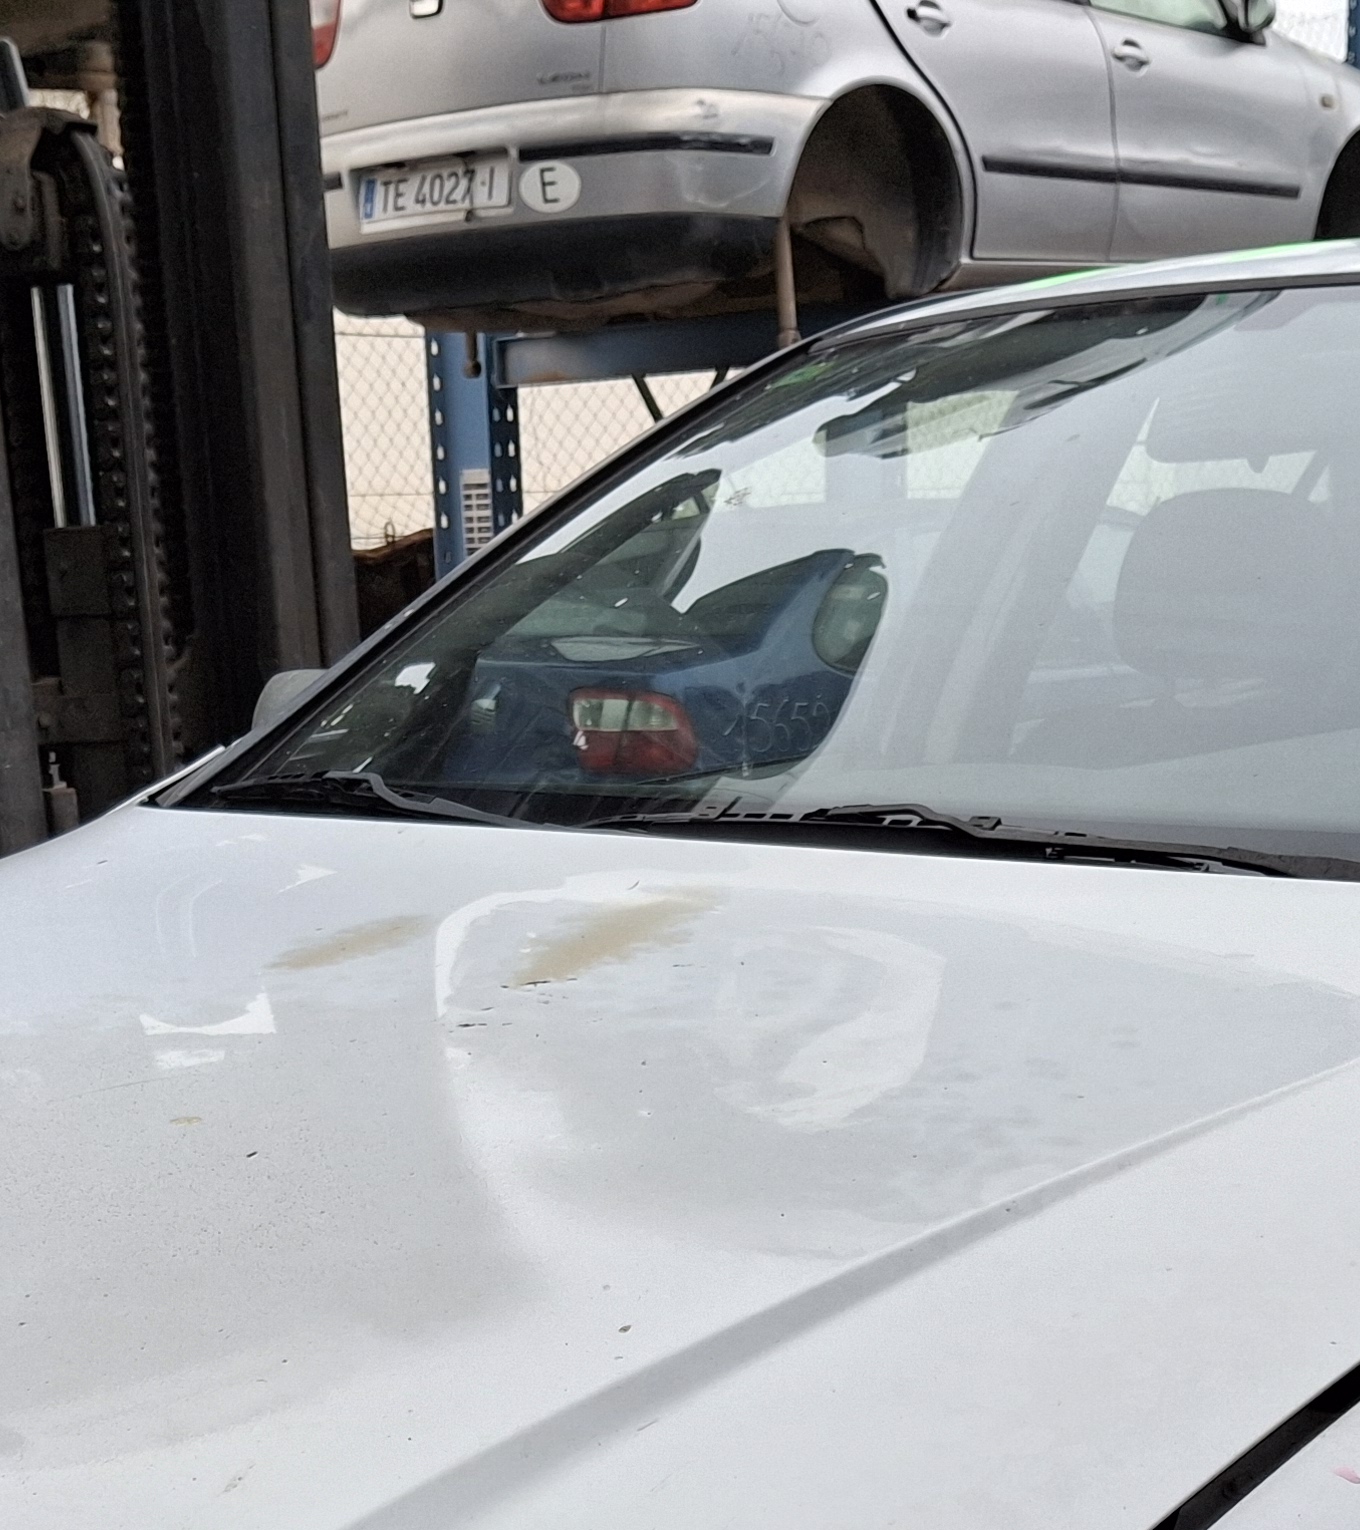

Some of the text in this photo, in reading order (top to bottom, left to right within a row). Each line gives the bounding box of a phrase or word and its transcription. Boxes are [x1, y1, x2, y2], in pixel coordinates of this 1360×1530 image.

[381, 178, 409, 213] TE
[414, 168, 476, 206] 4027
[539, 166, 560, 205] E
